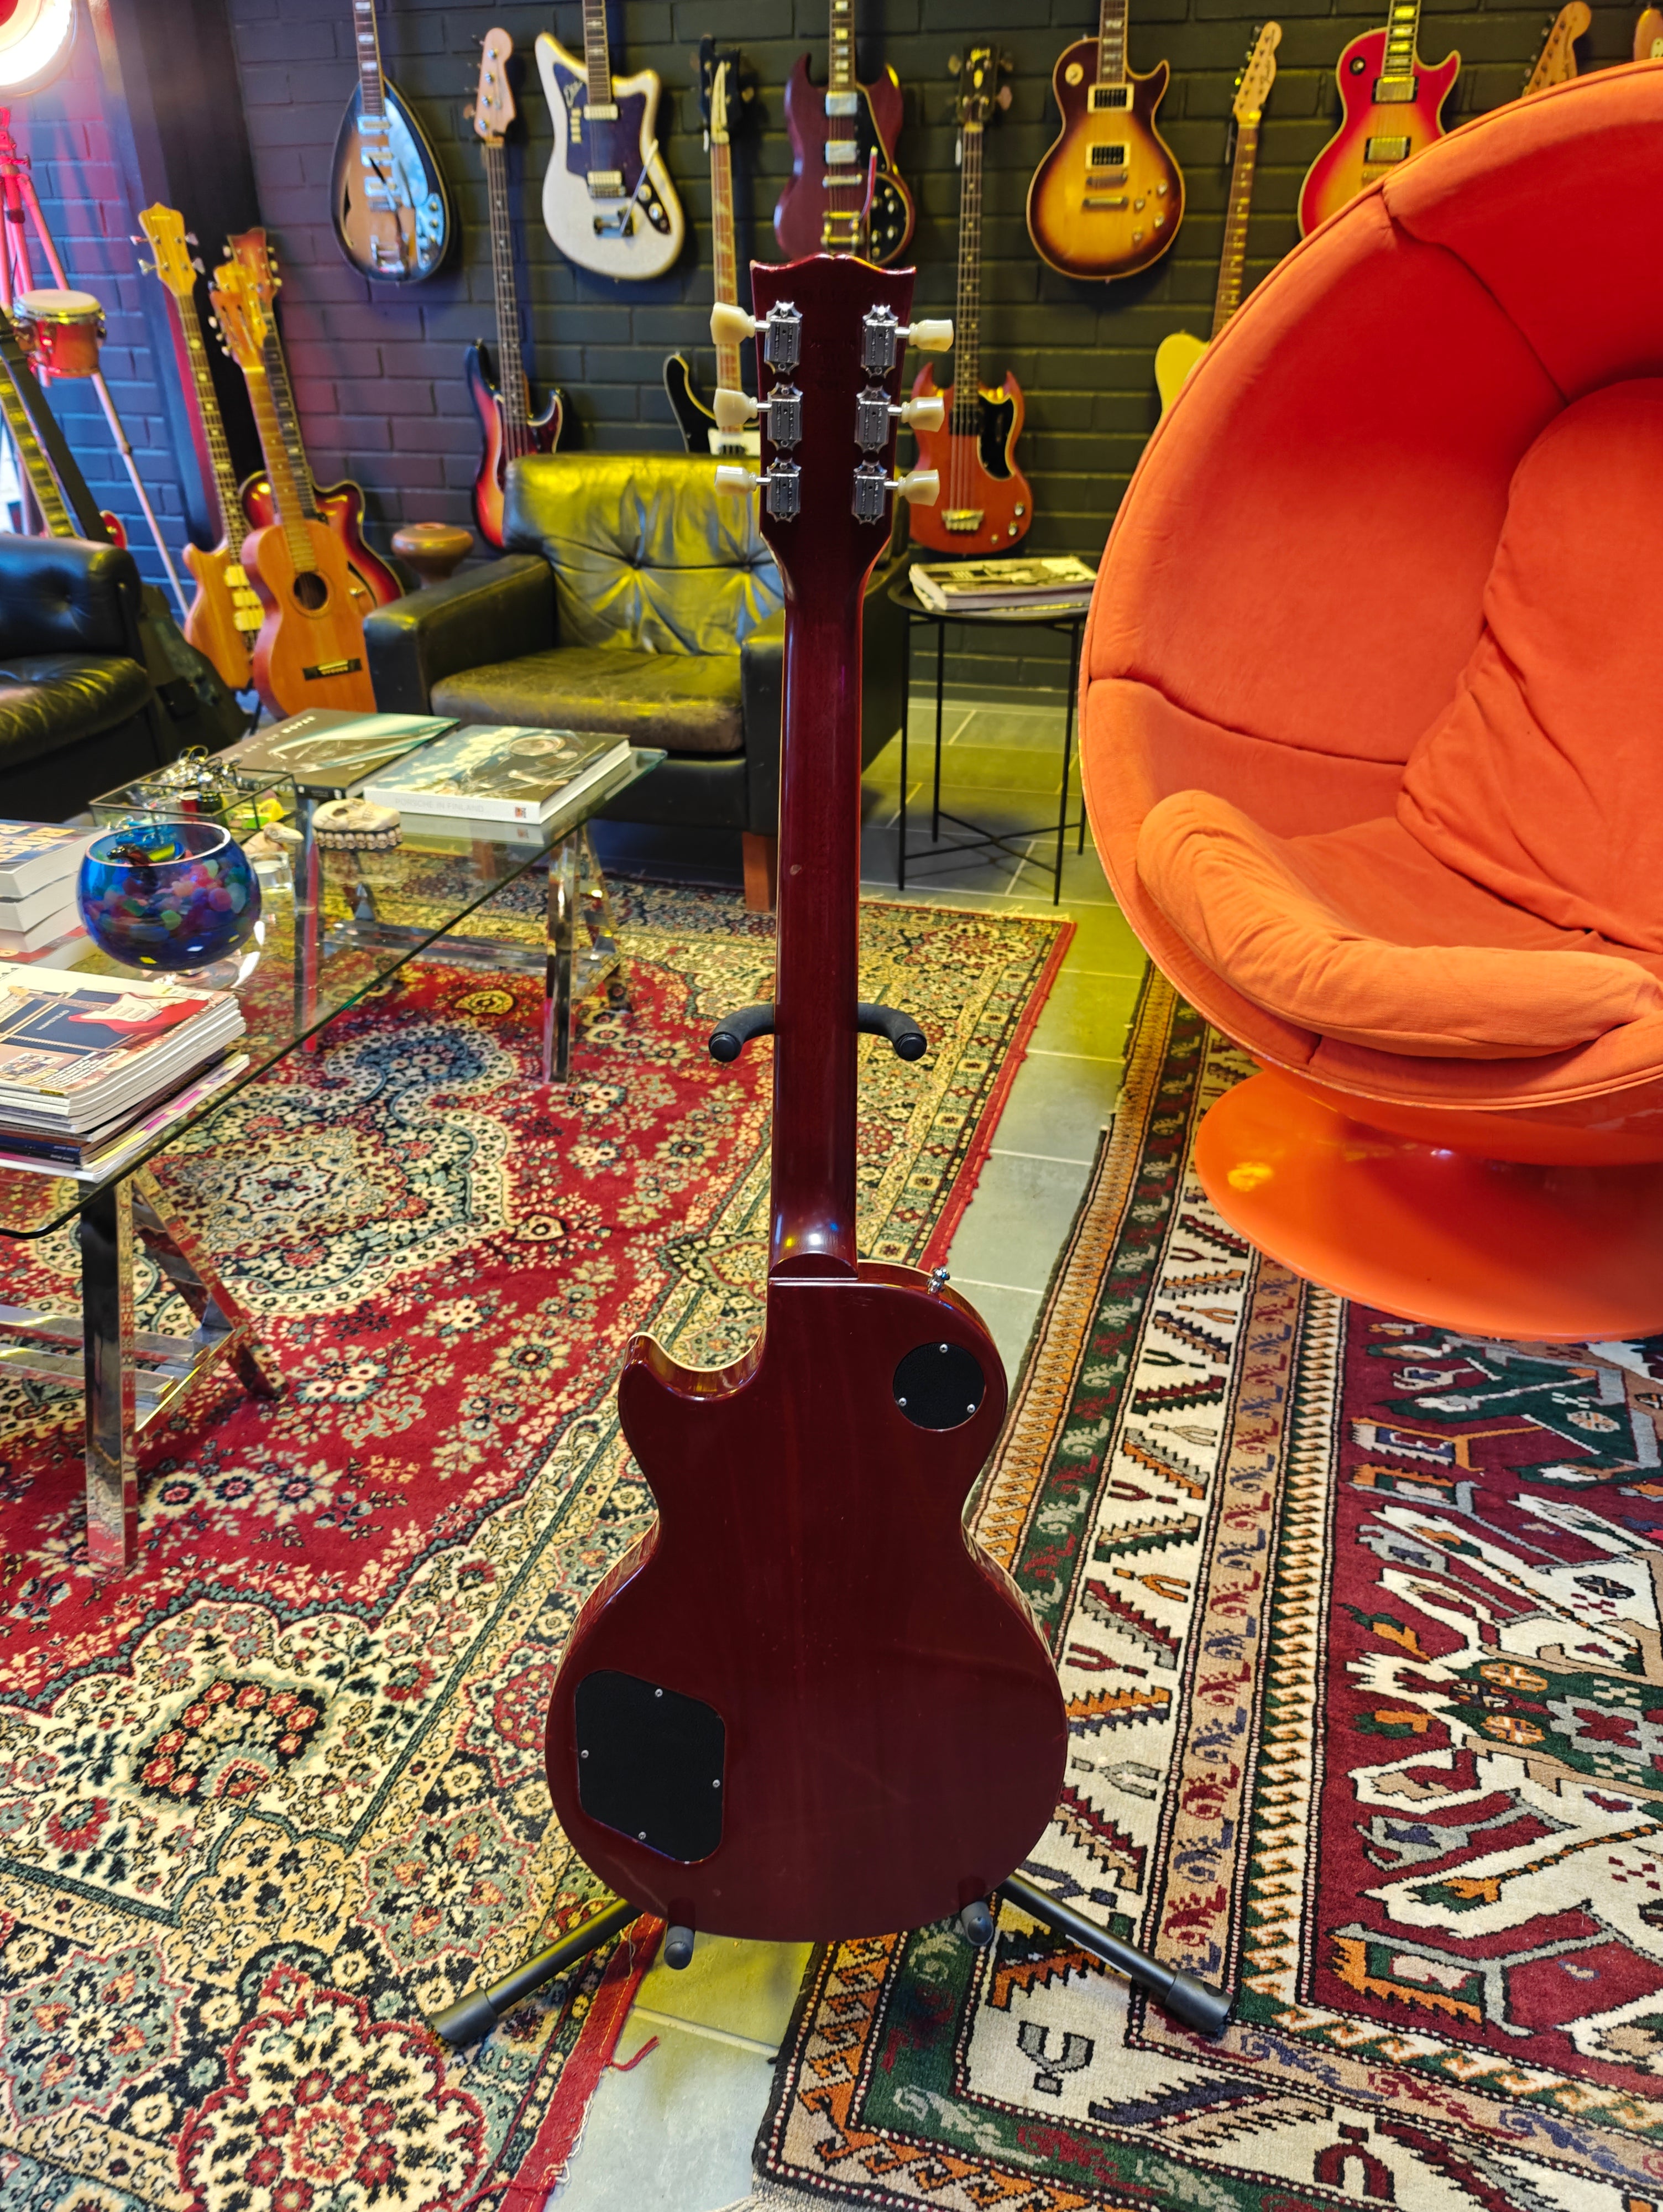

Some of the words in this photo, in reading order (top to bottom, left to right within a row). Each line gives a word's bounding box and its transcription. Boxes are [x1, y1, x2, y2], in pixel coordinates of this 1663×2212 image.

[281, 716, 316, 734] MOPAR
[395, 797, 434, 808] PORSCHE
[446, 802, 484, 812] FINLAND
